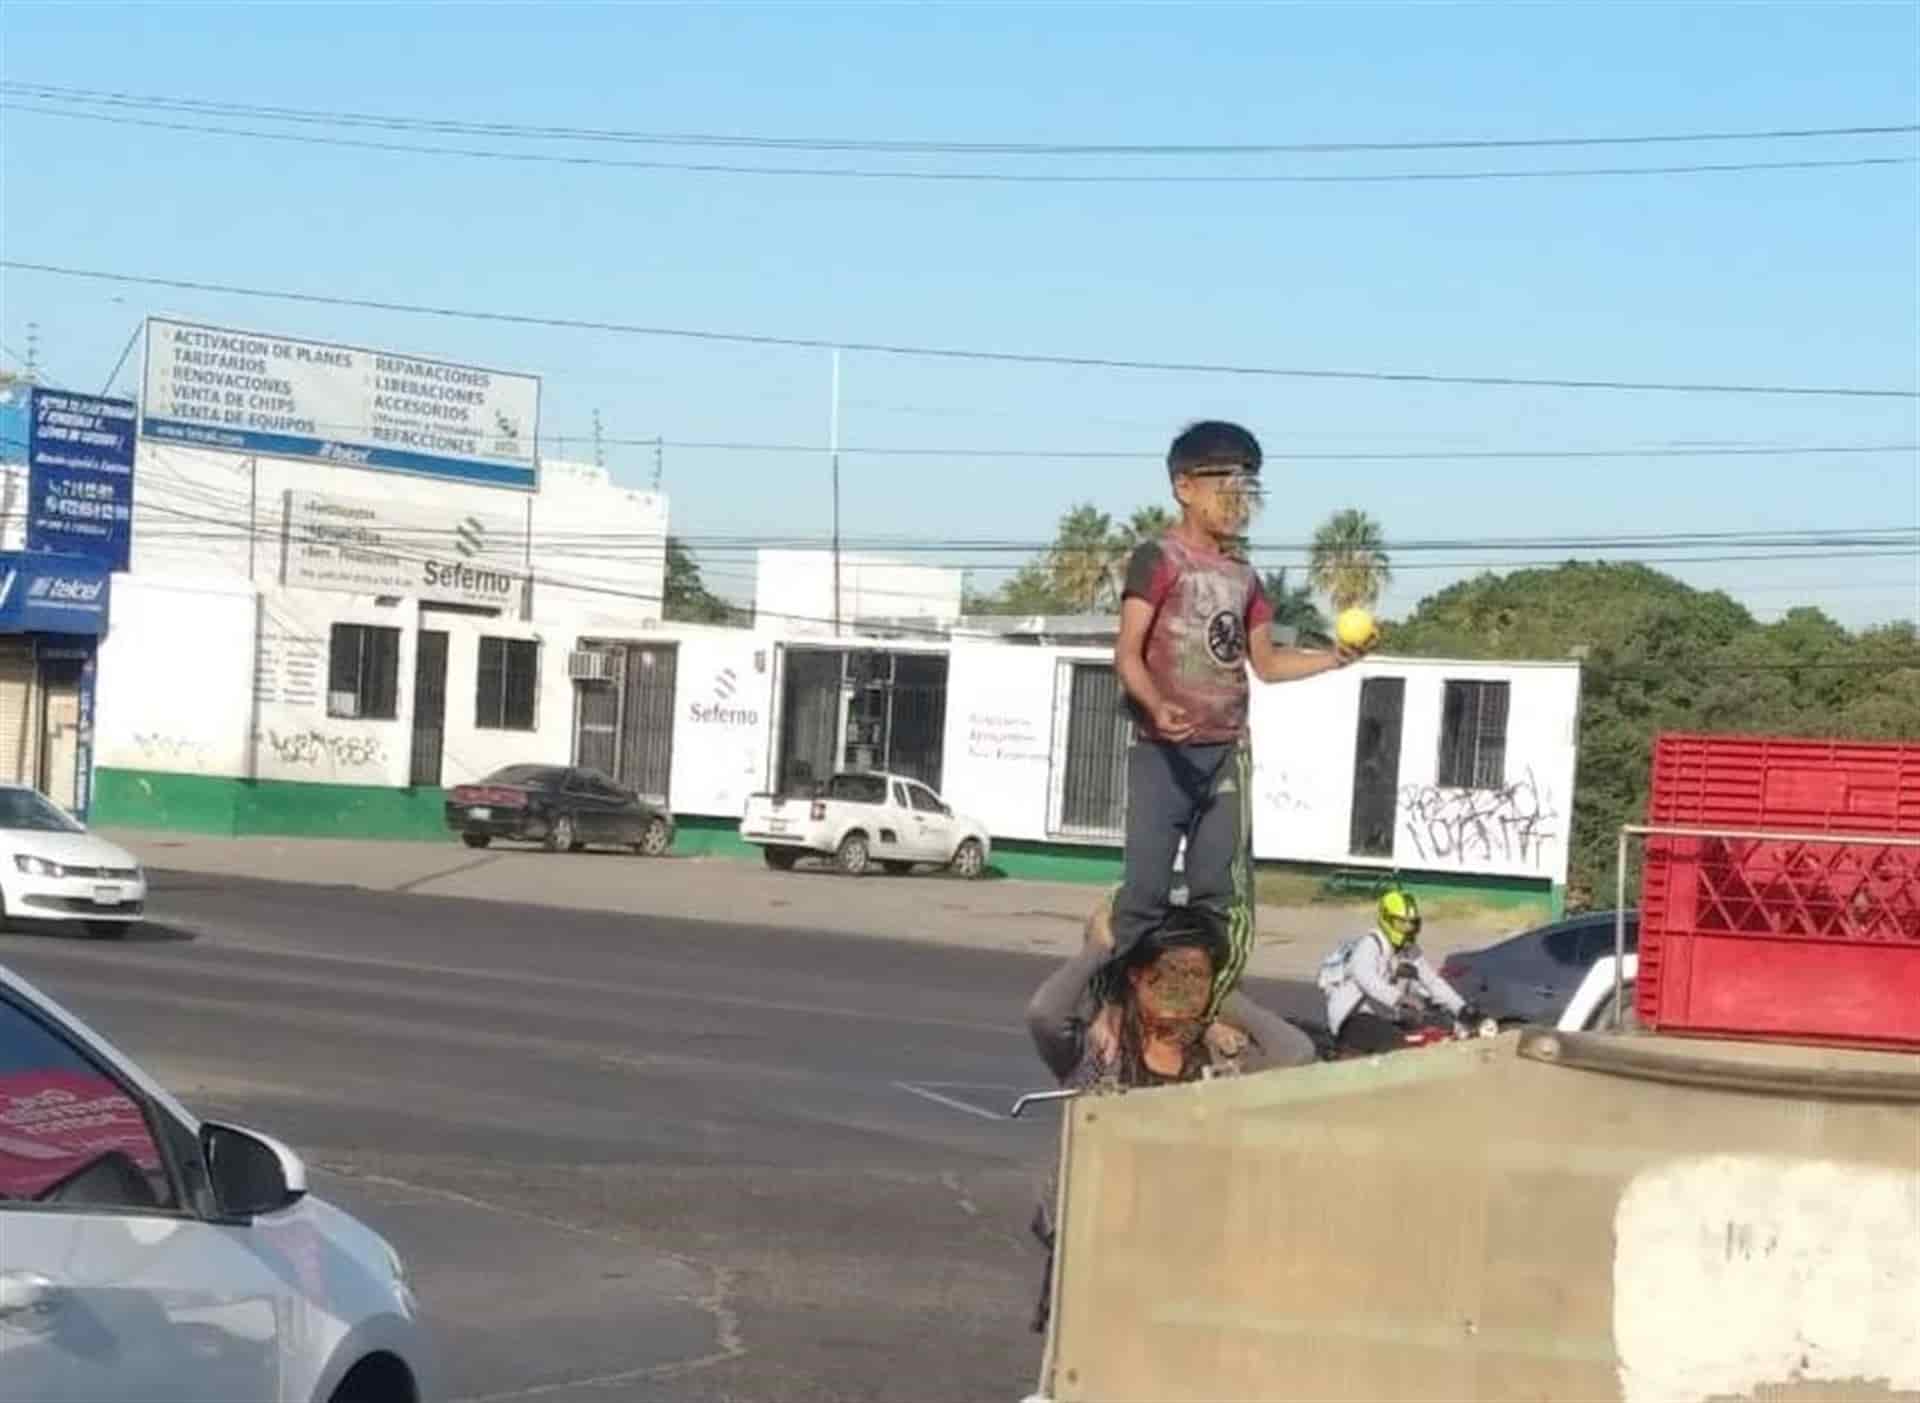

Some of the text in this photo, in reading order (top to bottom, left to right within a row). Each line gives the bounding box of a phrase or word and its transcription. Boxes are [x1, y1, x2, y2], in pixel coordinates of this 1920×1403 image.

[173, 329, 353, 368] ACTIVACION DE PLANES
[173, 348, 267, 374] TARIFARIOS
[172, 366, 293, 395] RENOVACIONES
[375, 358, 491, 387] REPARACIONES
[171, 383, 296, 413] VENTA DE CHIPS
[375, 375, 485, 405] LIBERACIONES
[170, 402, 316, 433] VENTA DE EQUIPOS
[373, 395, 469, 421] ACCESORIOS
[372, 426, 478, 454] REFACCIONES
[423, 560, 512, 593] Seferno
[688, 702, 760, 726] Seferno
